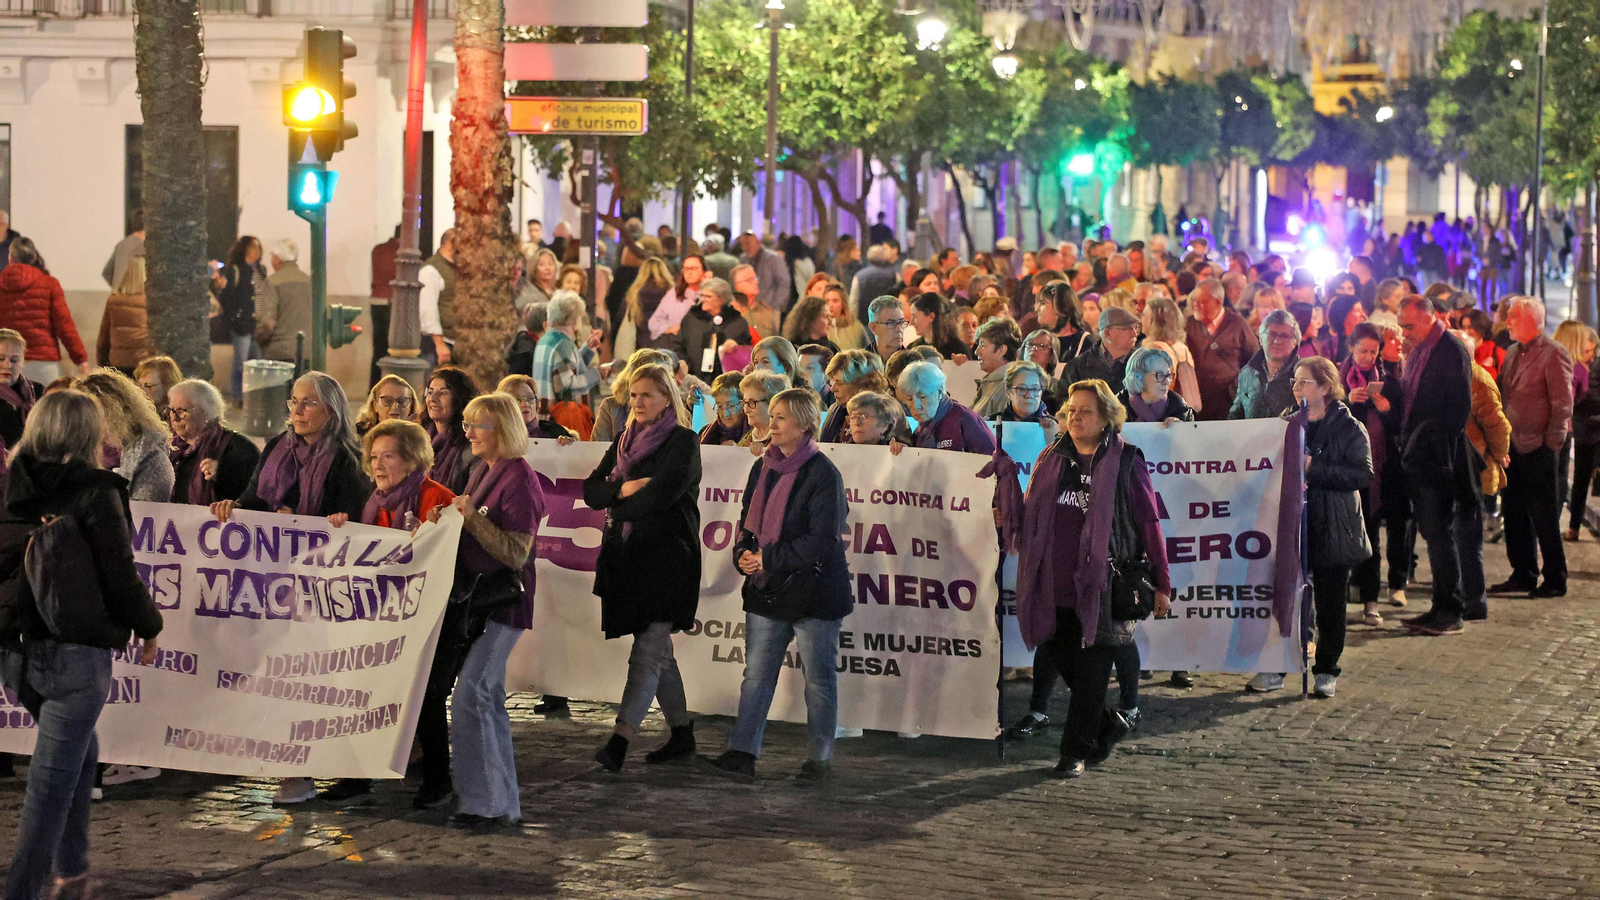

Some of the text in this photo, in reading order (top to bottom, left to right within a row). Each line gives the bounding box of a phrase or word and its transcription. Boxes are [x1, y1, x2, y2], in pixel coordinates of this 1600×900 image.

[541, 103, 637, 114] oficina municipal
[551, 117, 637, 129] de turismo
[1245, 457, 1273, 471] LA
[870, 489, 944, 511] CONTRA
[950, 496, 971, 512] LA
[1189, 501, 1230, 519] DE
[197, 519, 350, 568] CONTRA
[912, 537, 940, 560] DE
[195, 568, 427, 622] MACHISTAS
[848, 572, 977, 612] NERO
[1186, 607, 1271, 619] FUTURO
[712, 645, 744, 664] LA
[863, 632, 982, 658] MUJERES
[265, 635, 406, 679] DENUNCIA
[217, 669, 372, 710] SOLIDARIDAD
[164, 725, 311, 765] FORTALEZA
